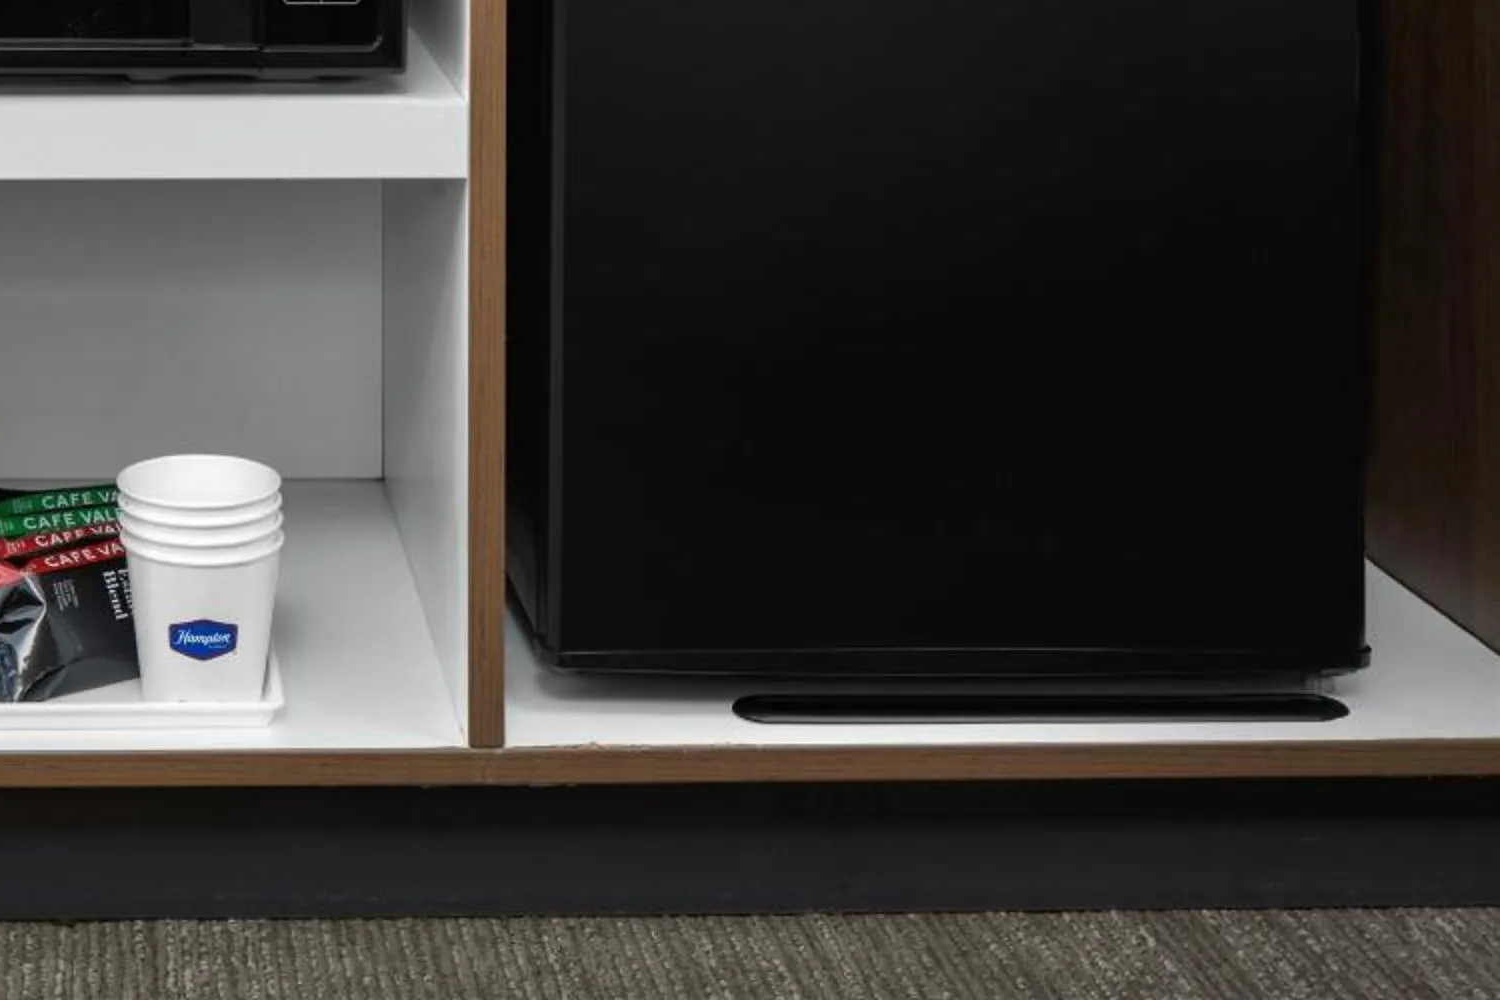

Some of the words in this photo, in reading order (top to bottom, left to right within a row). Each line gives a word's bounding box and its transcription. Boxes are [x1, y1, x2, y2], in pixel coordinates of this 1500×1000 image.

[41, 491, 93, 509] CAFE
[23, 513, 75, 530] CAFE
[35, 529, 87, 547] CAFE
[44, 549, 96, 567] CAFE
